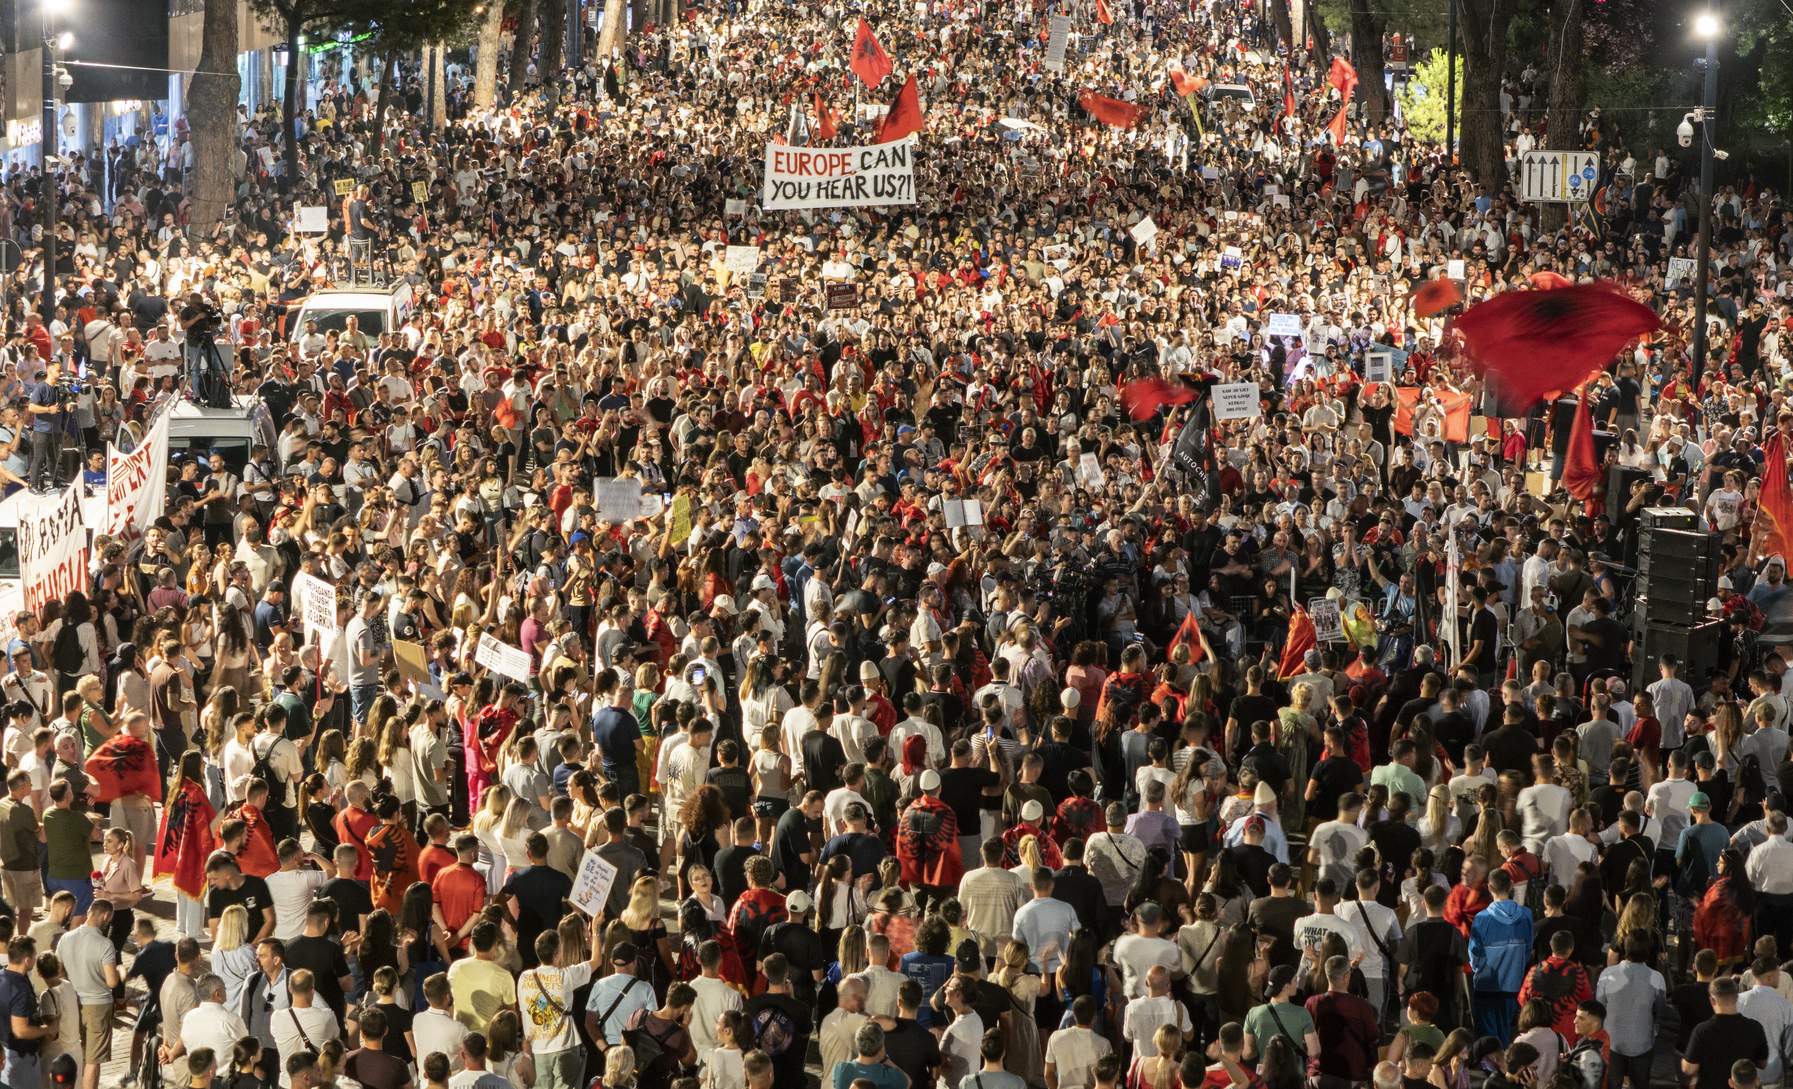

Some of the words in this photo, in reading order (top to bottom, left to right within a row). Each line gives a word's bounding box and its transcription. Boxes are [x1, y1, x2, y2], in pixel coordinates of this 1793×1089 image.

[860, 144, 906, 170] CAN
[771, 180, 810, 201] YOU
[817, 175, 870, 200] HEAR
[873, 174, 912, 200] US?!
[1671, 259, 1698, 273] REVOK
[306, 579, 333, 600] PROPAGANDA
[586, 862, 595, 874] BE
[1304, 927, 1328, 936] WHAT
